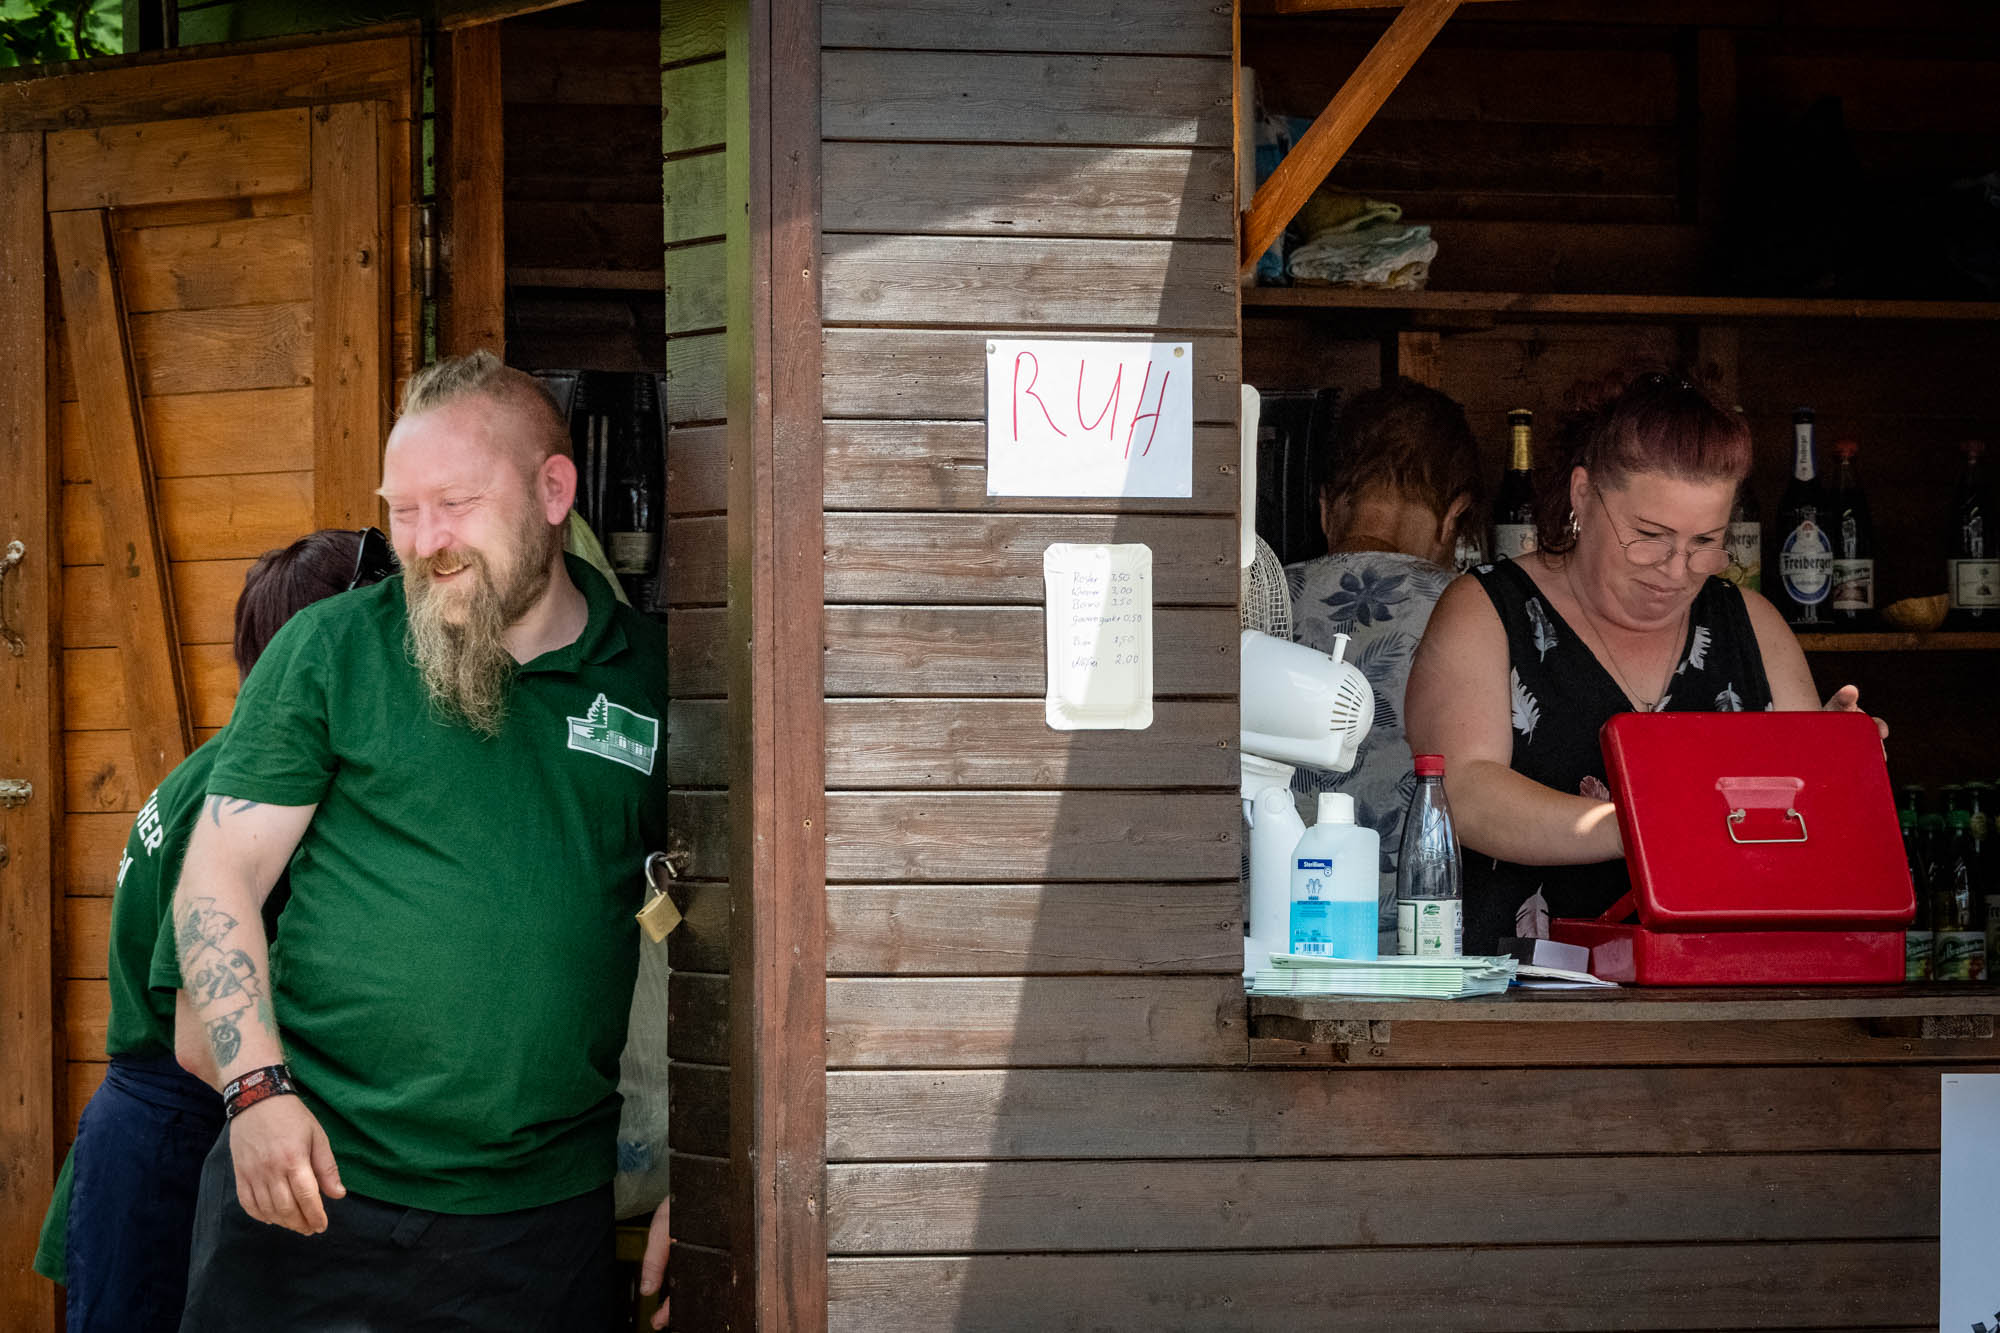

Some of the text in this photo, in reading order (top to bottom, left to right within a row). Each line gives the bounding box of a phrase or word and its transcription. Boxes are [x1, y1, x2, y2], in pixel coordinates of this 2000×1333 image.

[1013, 351, 1170, 459] RUH
[1783, 554, 1832, 573] Freiberger
[137, 788, 163, 857] HER
